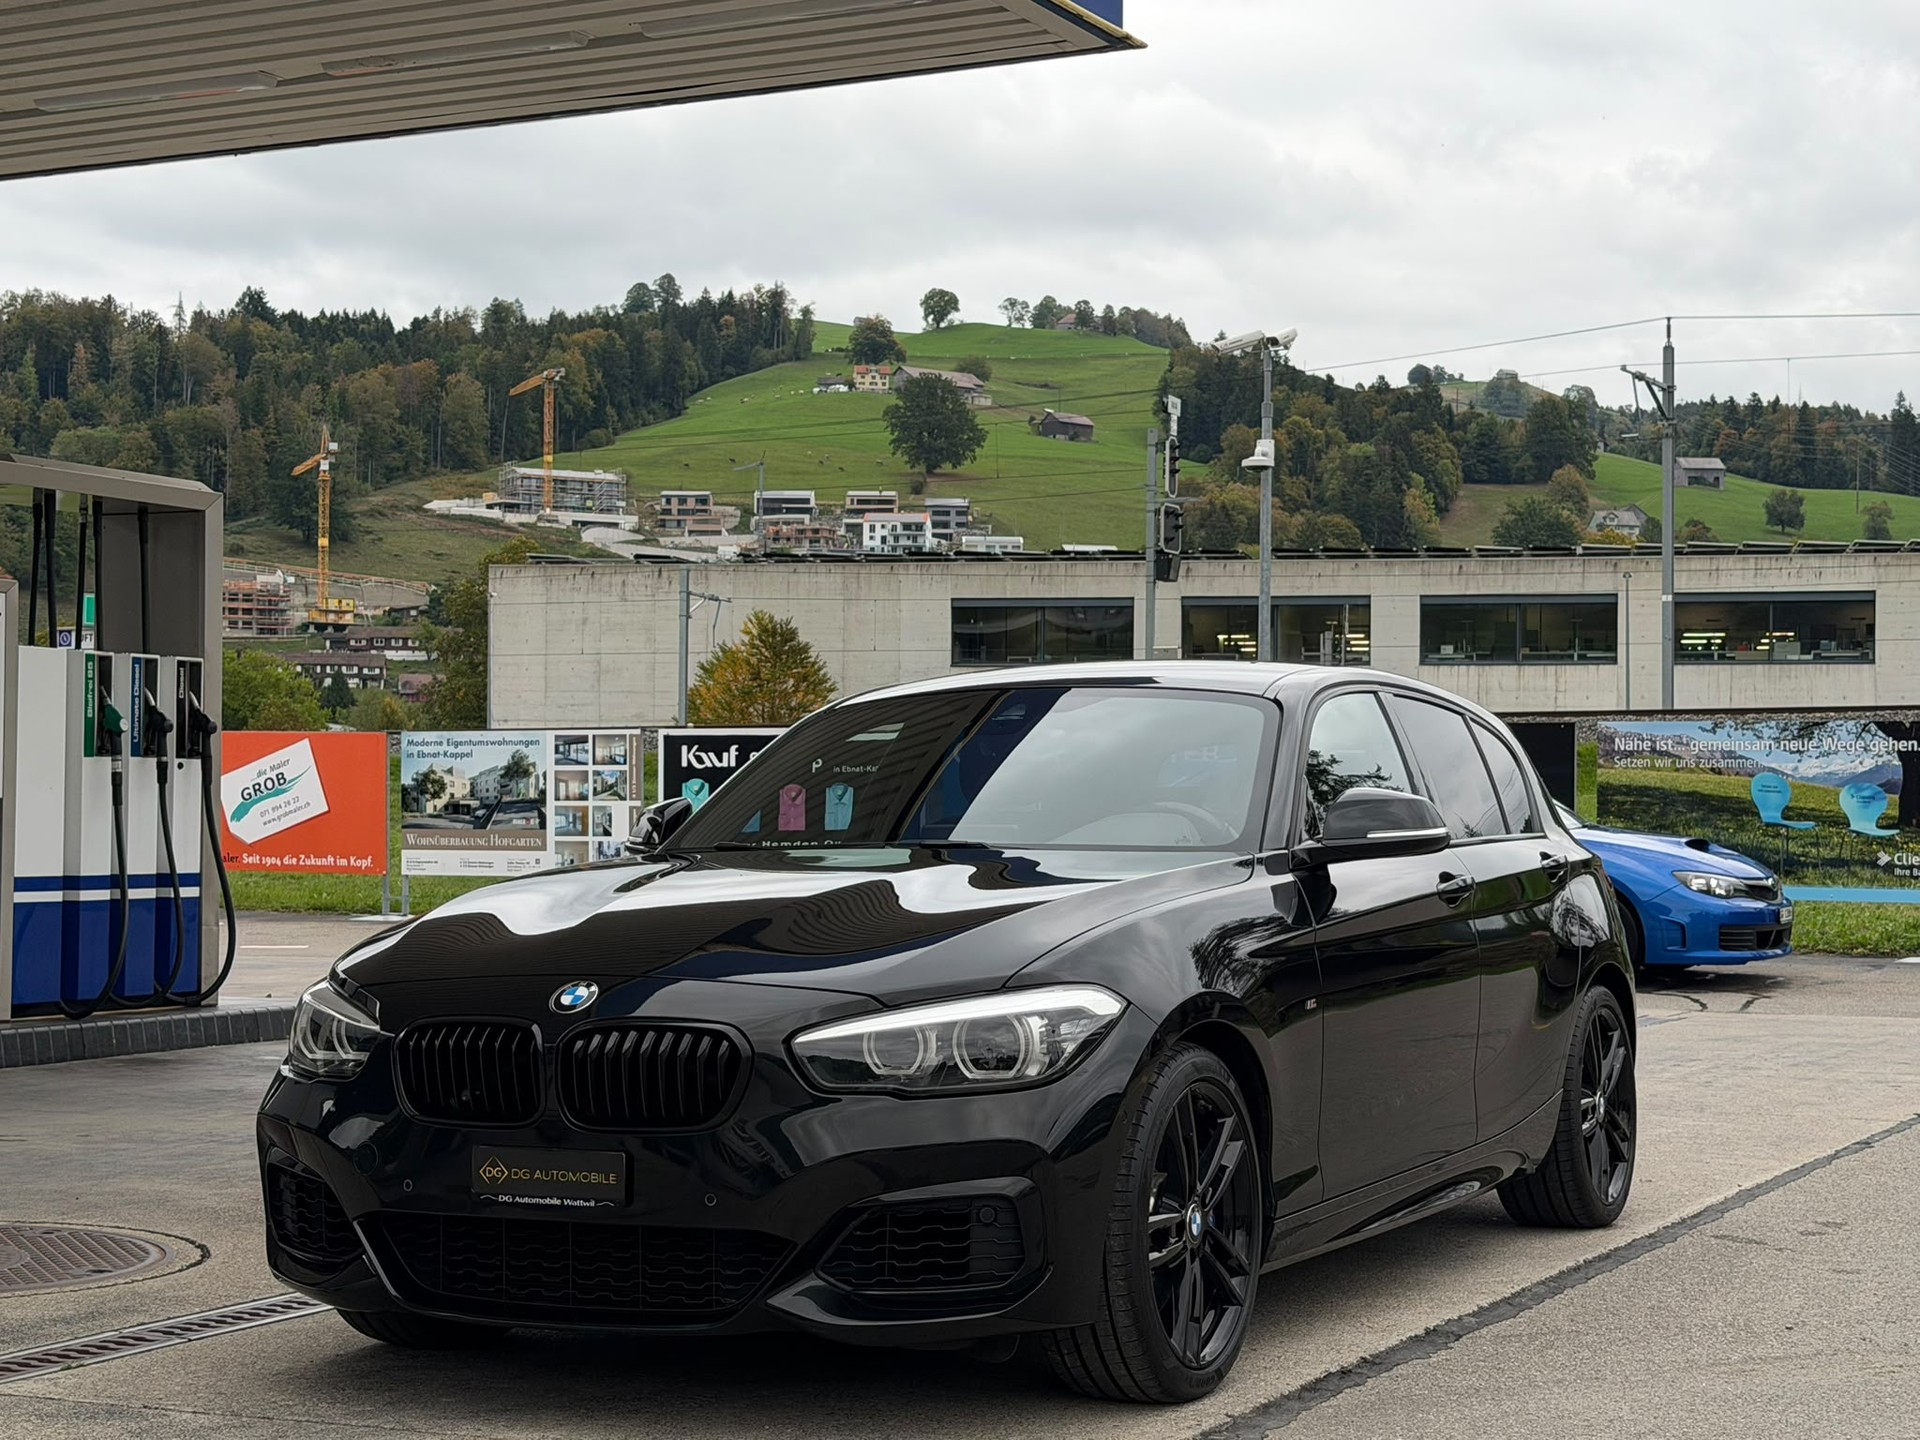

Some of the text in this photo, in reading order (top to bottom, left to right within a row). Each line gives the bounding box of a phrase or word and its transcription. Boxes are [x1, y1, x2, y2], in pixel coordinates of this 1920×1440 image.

[406, 737, 541, 749] Moderne Eigentumswohnungen
[1614, 736, 1651, 751] Nähe
[1655, 737, 1686, 751] ist...
[1690, 737, 1775, 754] gemeinsam
[1780, 739, 1817, 751] neue
[1822, 738, 1865, 754] Wege
[406, 749, 473, 761] in Ebnat-Kappel
[681, 744, 739, 769] Kauf
[269, 758, 291, 773] Maler
[1614, 756, 1764, 768] Setzen wir uns zusammen.
[241, 772, 287, 801] GROB
[242, 853, 260, 864] Seit
[261, 856, 281, 867] 1904
[282, 854, 297, 865] die
[299, 854, 335, 866] Zukunft
[336, 855, 348, 866] im
[350, 855, 374, 869] Kopf.
[1894, 868, 1911, 876] Ihre
[485, 1167, 502, 1177] DG
[511, 1168, 617, 1184] DG AUTOMOBILE
[514, 1196, 561, 1205] Automobile
[563, 1198, 595, 1207] Wattwil
